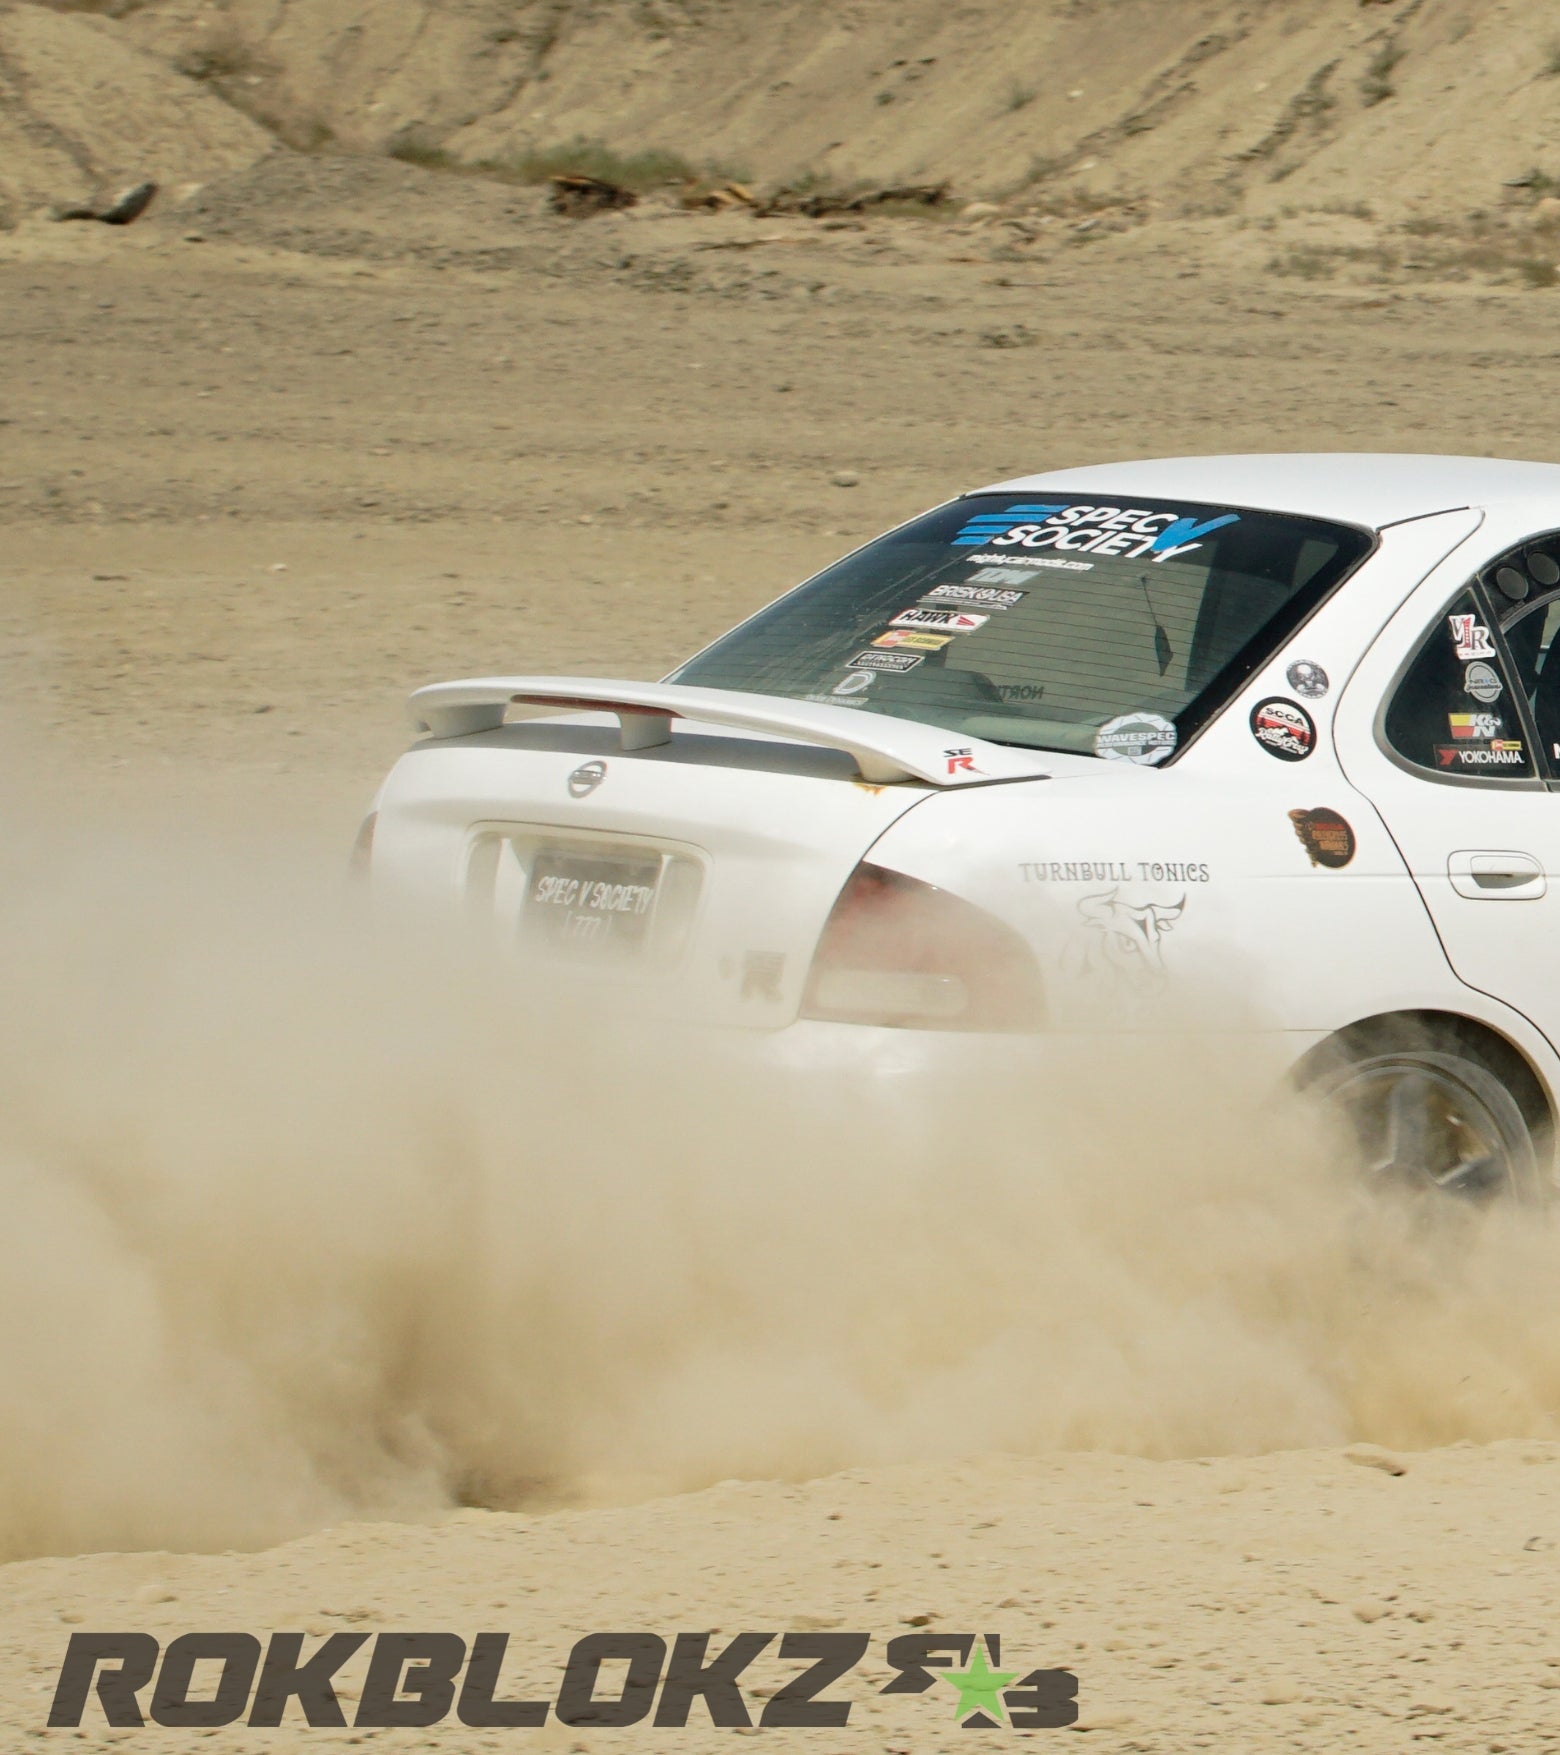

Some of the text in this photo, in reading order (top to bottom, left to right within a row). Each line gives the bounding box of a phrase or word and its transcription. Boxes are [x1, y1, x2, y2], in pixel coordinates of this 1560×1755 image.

[1046, 505, 1179, 533] SPEC
[992, 525, 1203, 563] SOCIETY
[1265, 707, 1304, 727] SCCA
[1098, 731, 1176, 743] WAVESPEC
[1459, 750, 1525, 763] YOKOHAMA
[1018, 862, 1210, 883] TURNBULL TONICS
[535, 876, 579, 905] SPEC
[589, 882, 654, 914] SOCIETY
